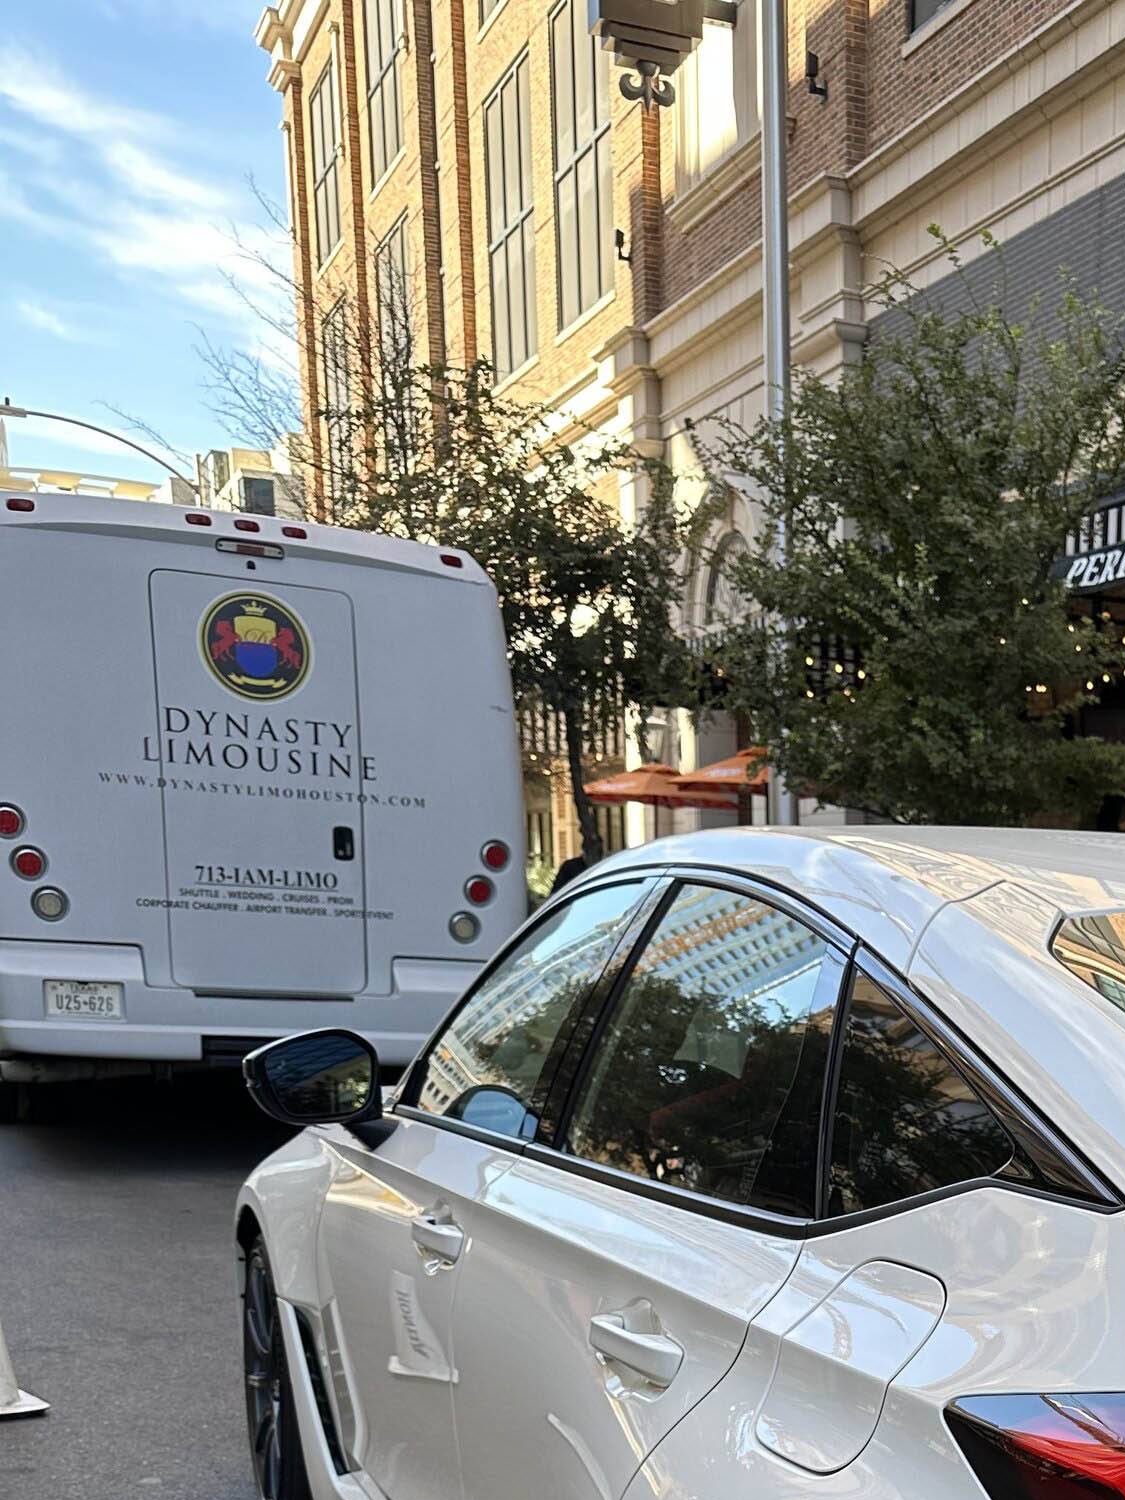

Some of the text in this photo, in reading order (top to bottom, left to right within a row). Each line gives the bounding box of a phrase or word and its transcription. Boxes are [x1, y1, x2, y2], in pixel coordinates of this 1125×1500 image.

[164, 707, 352, 748] DYNASTY
[143, 736, 377, 781] LIMOUSINE
[98, 772, 426, 808] WWW.DYNASTYLIMOHOUSTON.COM
[195, 865, 338, 891] 713-IAM-LIMO
[136, 898, 189, 909] CORPORATE
[246, 903, 282, 913] AIRPORT
[284, 905, 327, 916] TRANSFER
[179, 888, 219, 898] SHUTTLE
[227, 890, 274, 901] WEDDING
